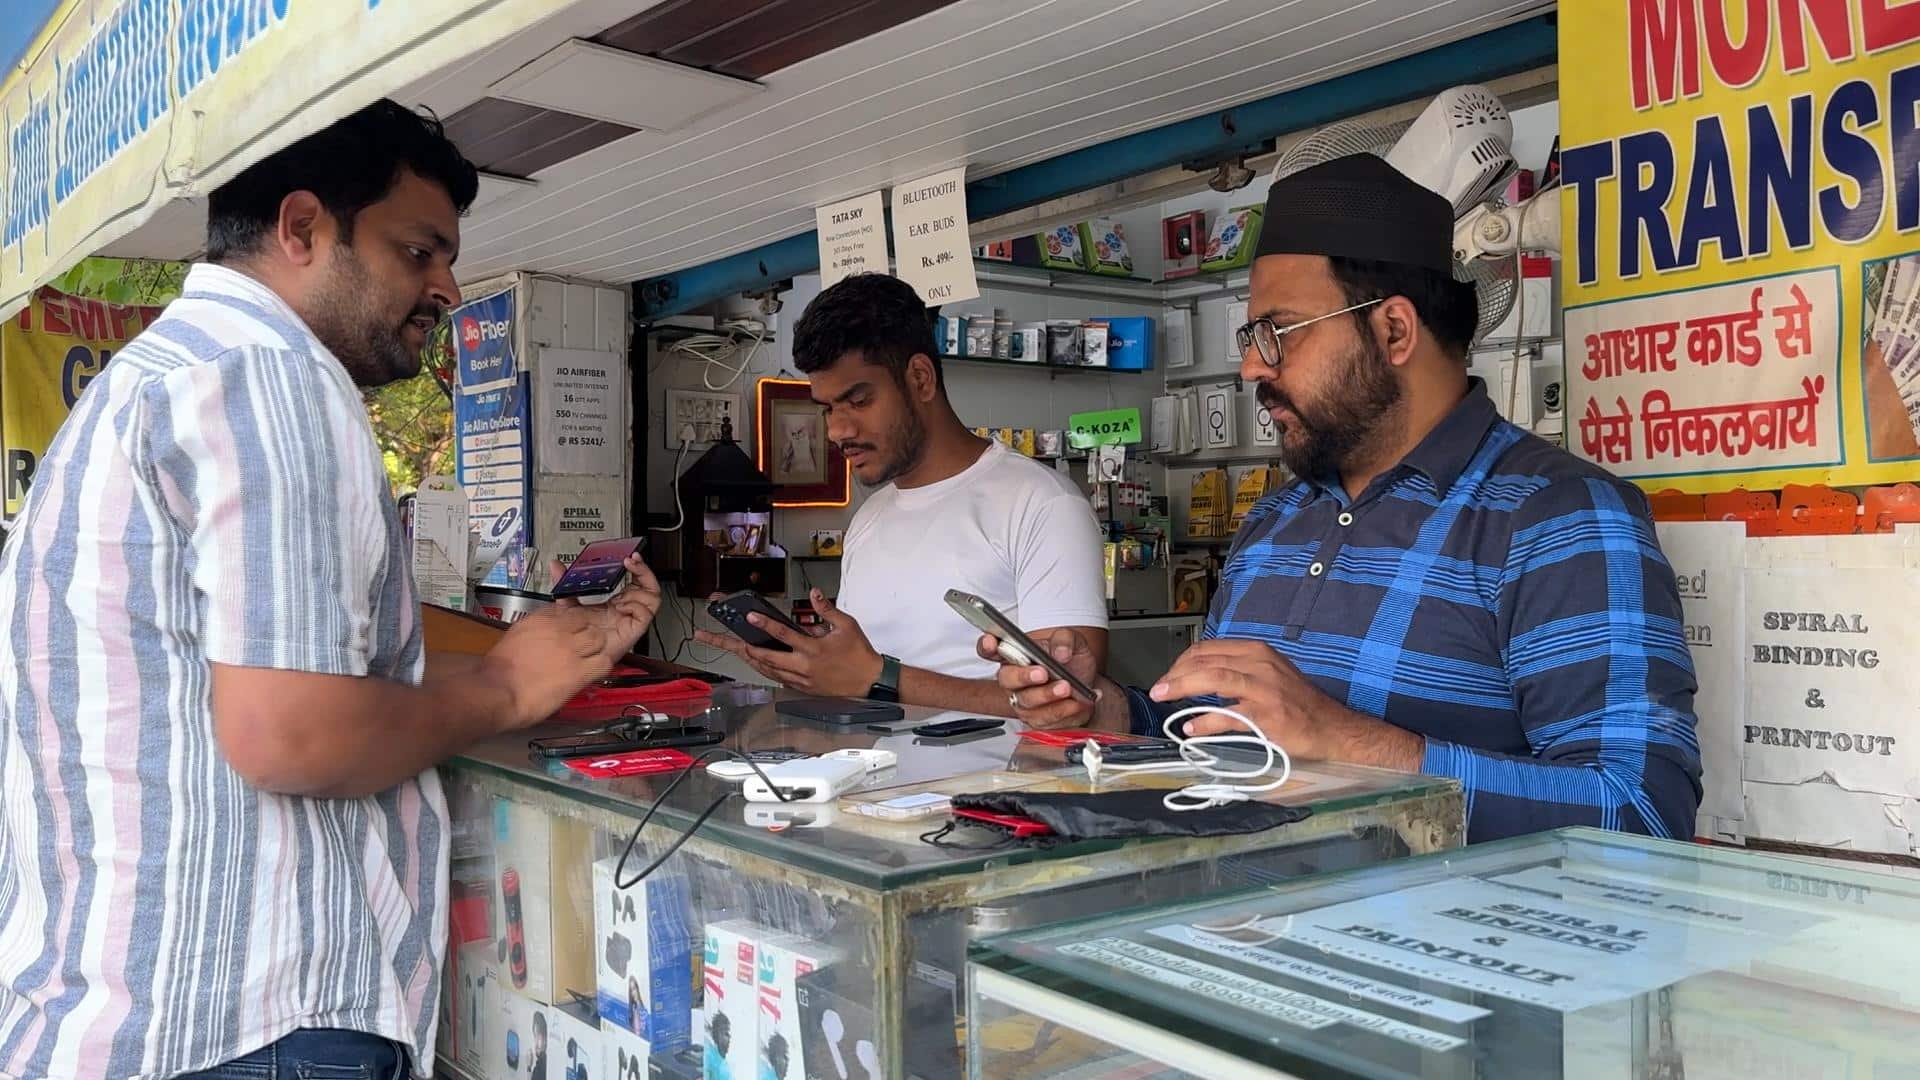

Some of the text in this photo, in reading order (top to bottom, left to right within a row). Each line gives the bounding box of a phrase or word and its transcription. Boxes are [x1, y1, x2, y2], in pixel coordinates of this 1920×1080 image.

[903, 180, 956, 205] BLUETOOTH
[832, 207, 864, 225] TATA SKY
[909, 215, 955, 237] EAR BUDS
[928, 284, 952, 300] ONLY
[464, 319, 510, 342] Jio Fiber
[1582, 321, 1680, 381] आधार
[1686, 287, 1763, 367] कार्ड
[1772, 284, 1812, 358] से
[556, 367, 606, 378] JIO AIRFIBER
[564, 393, 574, 402] 16
[556, 409, 571, 418] 550
[1579, 374, 1825, 464] पैसे निकलवायें
[563, 507, 601, 517] SPIRAL
[559, 521, 605, 530] BINDING
[579, 537, 587, 546] &
[1763, 611, 1868, 634] SPIRAL
[1752, 644, 1880, 669] BINDING
[1804, 688, 1826, 708] &
[1744, 724, 1895, 756] PRINTOUT
[1440, 908, 1637, 952] BINDING
[1489, 903, 1649, 940] SPIRAL
[1472, 934, 1508, 947] &
[1341, 924, 1575, 983] PRINTOUT
